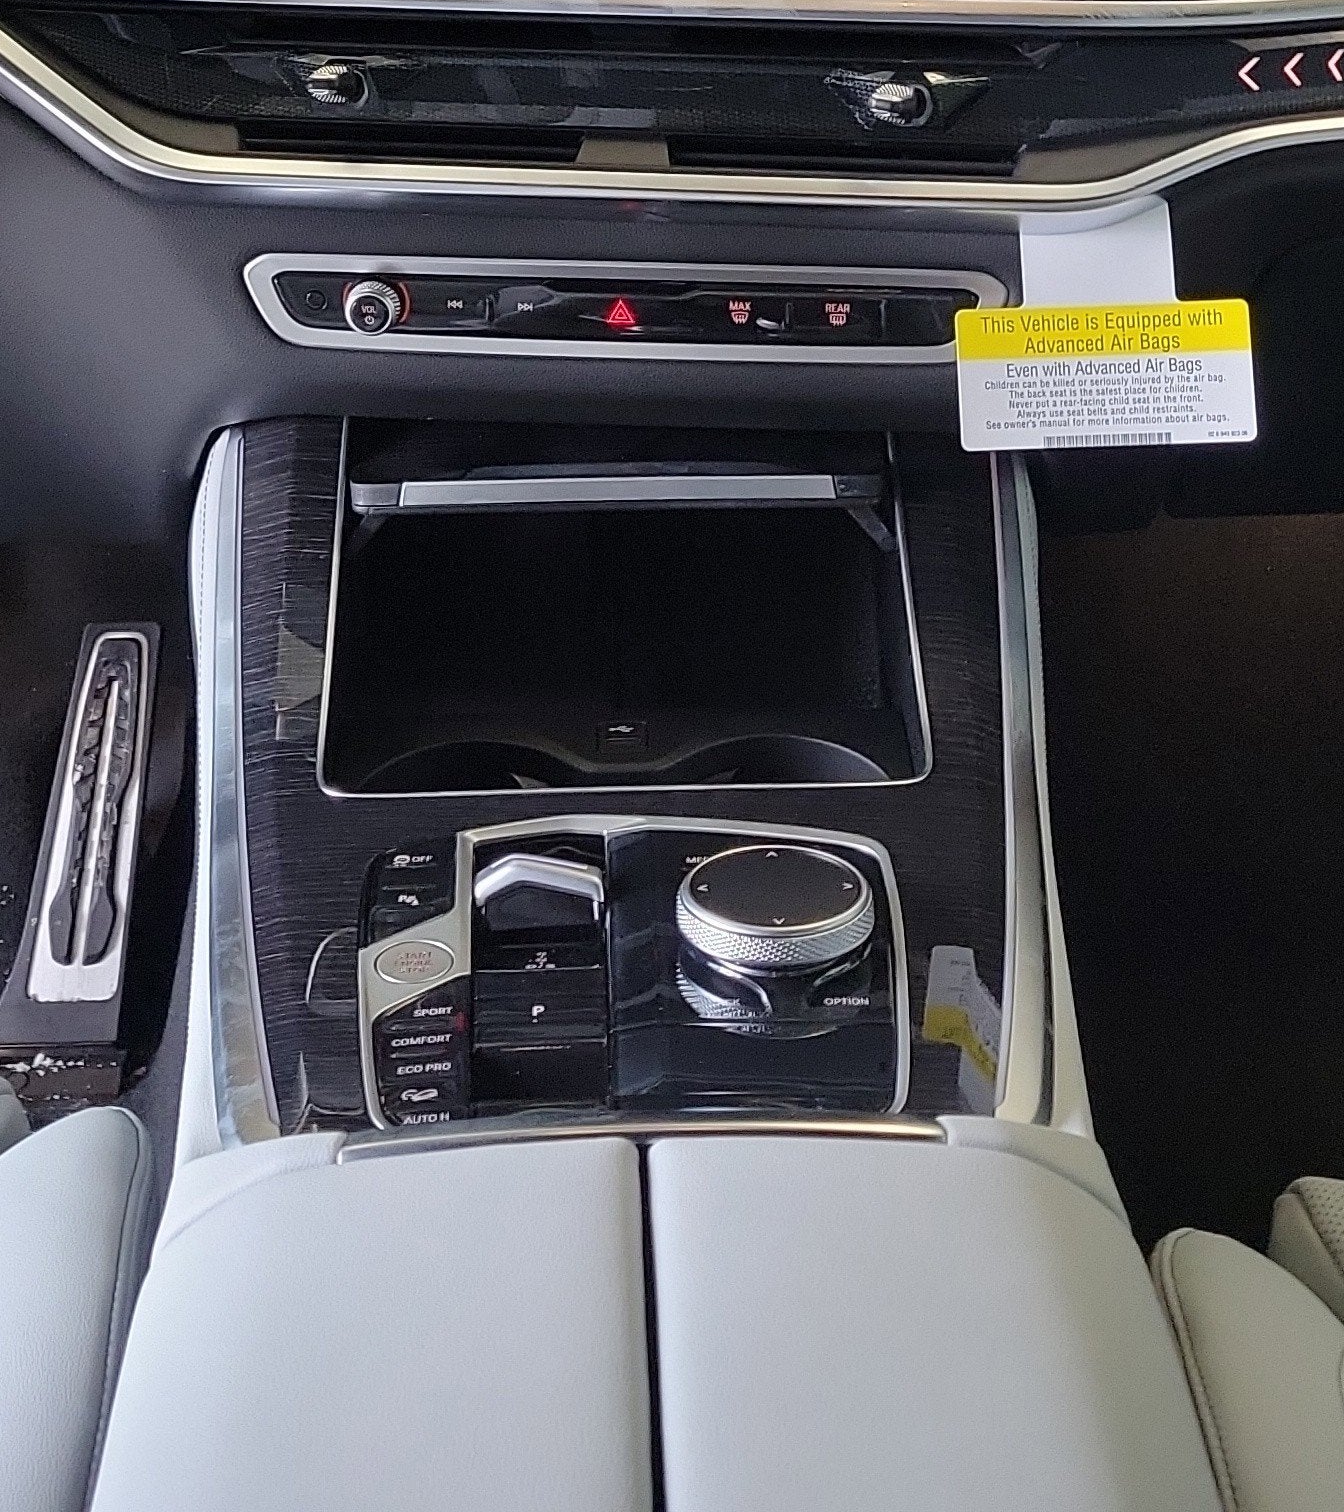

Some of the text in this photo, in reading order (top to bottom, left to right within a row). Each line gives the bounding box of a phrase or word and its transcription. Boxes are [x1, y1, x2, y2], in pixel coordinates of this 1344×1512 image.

[729, 300, 752, 311] MAX
[825, 303, 851, 314] REAR
[980, 308, 1223, 334] This Vehicle is Equipped with
[1024, 333, 1180, 354] Advanced Air Bags
[1006, 357, 1203, 378] Even with Advanced Air Bags
[984, 380, 1020, 390] Children
[1022, 381, 1037, 389] can
[1040, 380, 1050, 388] be
[1053, 378, 1076, 387] killed
[1090, 376, 1128, 387] seriously
[1131, 376, 1161, 386] injured
[1164, 375, 1174, 385] by
[1177, 374, 1191, 383] the
[1193, 374, 1205, 382] air
[1207, 373, 1226, 383] bag.
[1009, 384, 1203, 399] The back seat is the safest place for children.
[1009, 400, 1033, 409] Never
[1036, 400, 1050, 409] put
[1060, 397, 1106, 408] rear-facing
[1109, 397, 1130, 406] child
[1132, 396, 1150, 405] seat
[1153, 396, 1161, 404] in
[1163, 395, 1177, 403] the
[1179, 393, 1204, 402] front.
[1016, 409, 1047, 419] Always
[1066, 408, 1084, 417] seat
[1087, 407, 1108, 416] belts
[1110, 406, 1126, 415] and
[1128, 405, 1150, 414] child
[1152, 404, 1197, 414] restraints.
[986, 413, 1230, 430] See owner's manual for more information about air bags.
[822, 997, 870, 1006] OPTION
[413, 1006, 454, 1018] SPORT
[531, 1005, 545, 1017] P
[391, 1033, 453, 1047] COMFORT
[396, 1061, 452, 1076] ECO PRO
[403, 1111, 450, 1126] AUTO H
